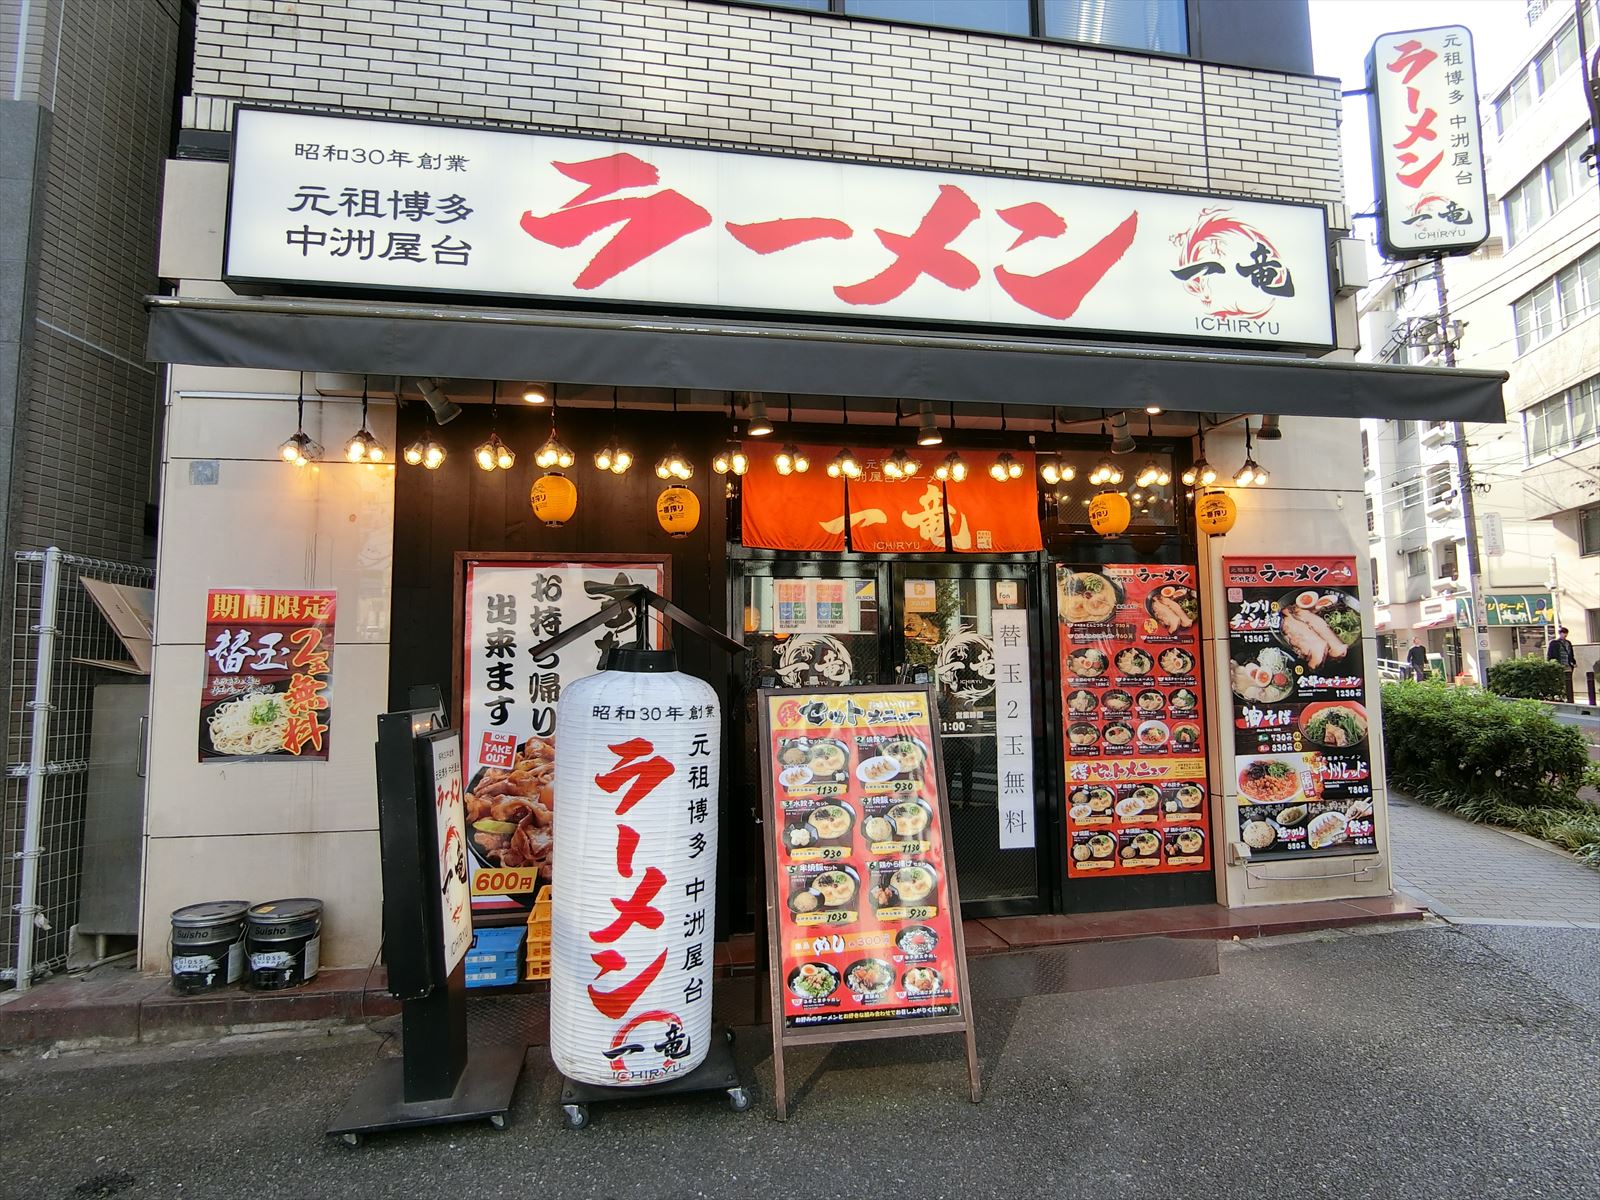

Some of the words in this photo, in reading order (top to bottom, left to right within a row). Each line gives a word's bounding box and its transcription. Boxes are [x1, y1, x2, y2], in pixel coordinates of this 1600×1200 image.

[1442, 34, 1464, 105] 元祖博多
[1386, 39, 1445, 189] ラーメン
[294, 142, 471, 173] 昭和30年創業
[1450, 114, 1473, 185] 中洲屋台
[287, 184, 475, 225] 元祖博多
[1402, 200, 1474, 225] 一竜
[285, 224, 473, 267] 中洲屋台
[519, 152, 1138, 321] ラーメン
[1414, 228, 1467, 240] ICHIRYU
[1170, 242, 1296, 298] 一竜
[1194, 316, 1281, 337] ICHIRYU
[818, 483, 972, 550] 一竜
[873, 541, 921, 551] ICHIRYU
[1136, 568, 1190, 583] ラーメン
[1259, 564, 1328, 583] ラーメン
[212, 593, 331, 620] 期間限定
[207, 629, 291, 674] 替玉
[484, 593, 517, 726] 出来ます
[592, 704, 716, 722] 昭和30年創業
[1242, 705, 1292, 729] 油そば
[1000, 624, 1027, 834] 替玉2玉無料
[484, 743, 512, 755] TAKE
[485, 753, 507, 764] OUT
[1092, 761, 1171, 779] セットメニュー
[687, 733, 711, 859] 元祖博多
[816, 786, 838, 795] 1130
[894, 782, 913, 792] 930
[823, 849, 842, 859] 930
[475, 871, 533, 891] 600円
[587, 737, 676, 1020] ラーメン
[827, 912, 848, 922] 1030
[909, 908, 927, 918] 930
[177, 929, 209, 939] Suisho
[255, 926, 287, 936] Suisho
[681, 877, 705, 1004] 中洲屋台
[601, 1023, 691, 1060] 一竜
[612, 1063, 686, 1081] ICHIRYU
